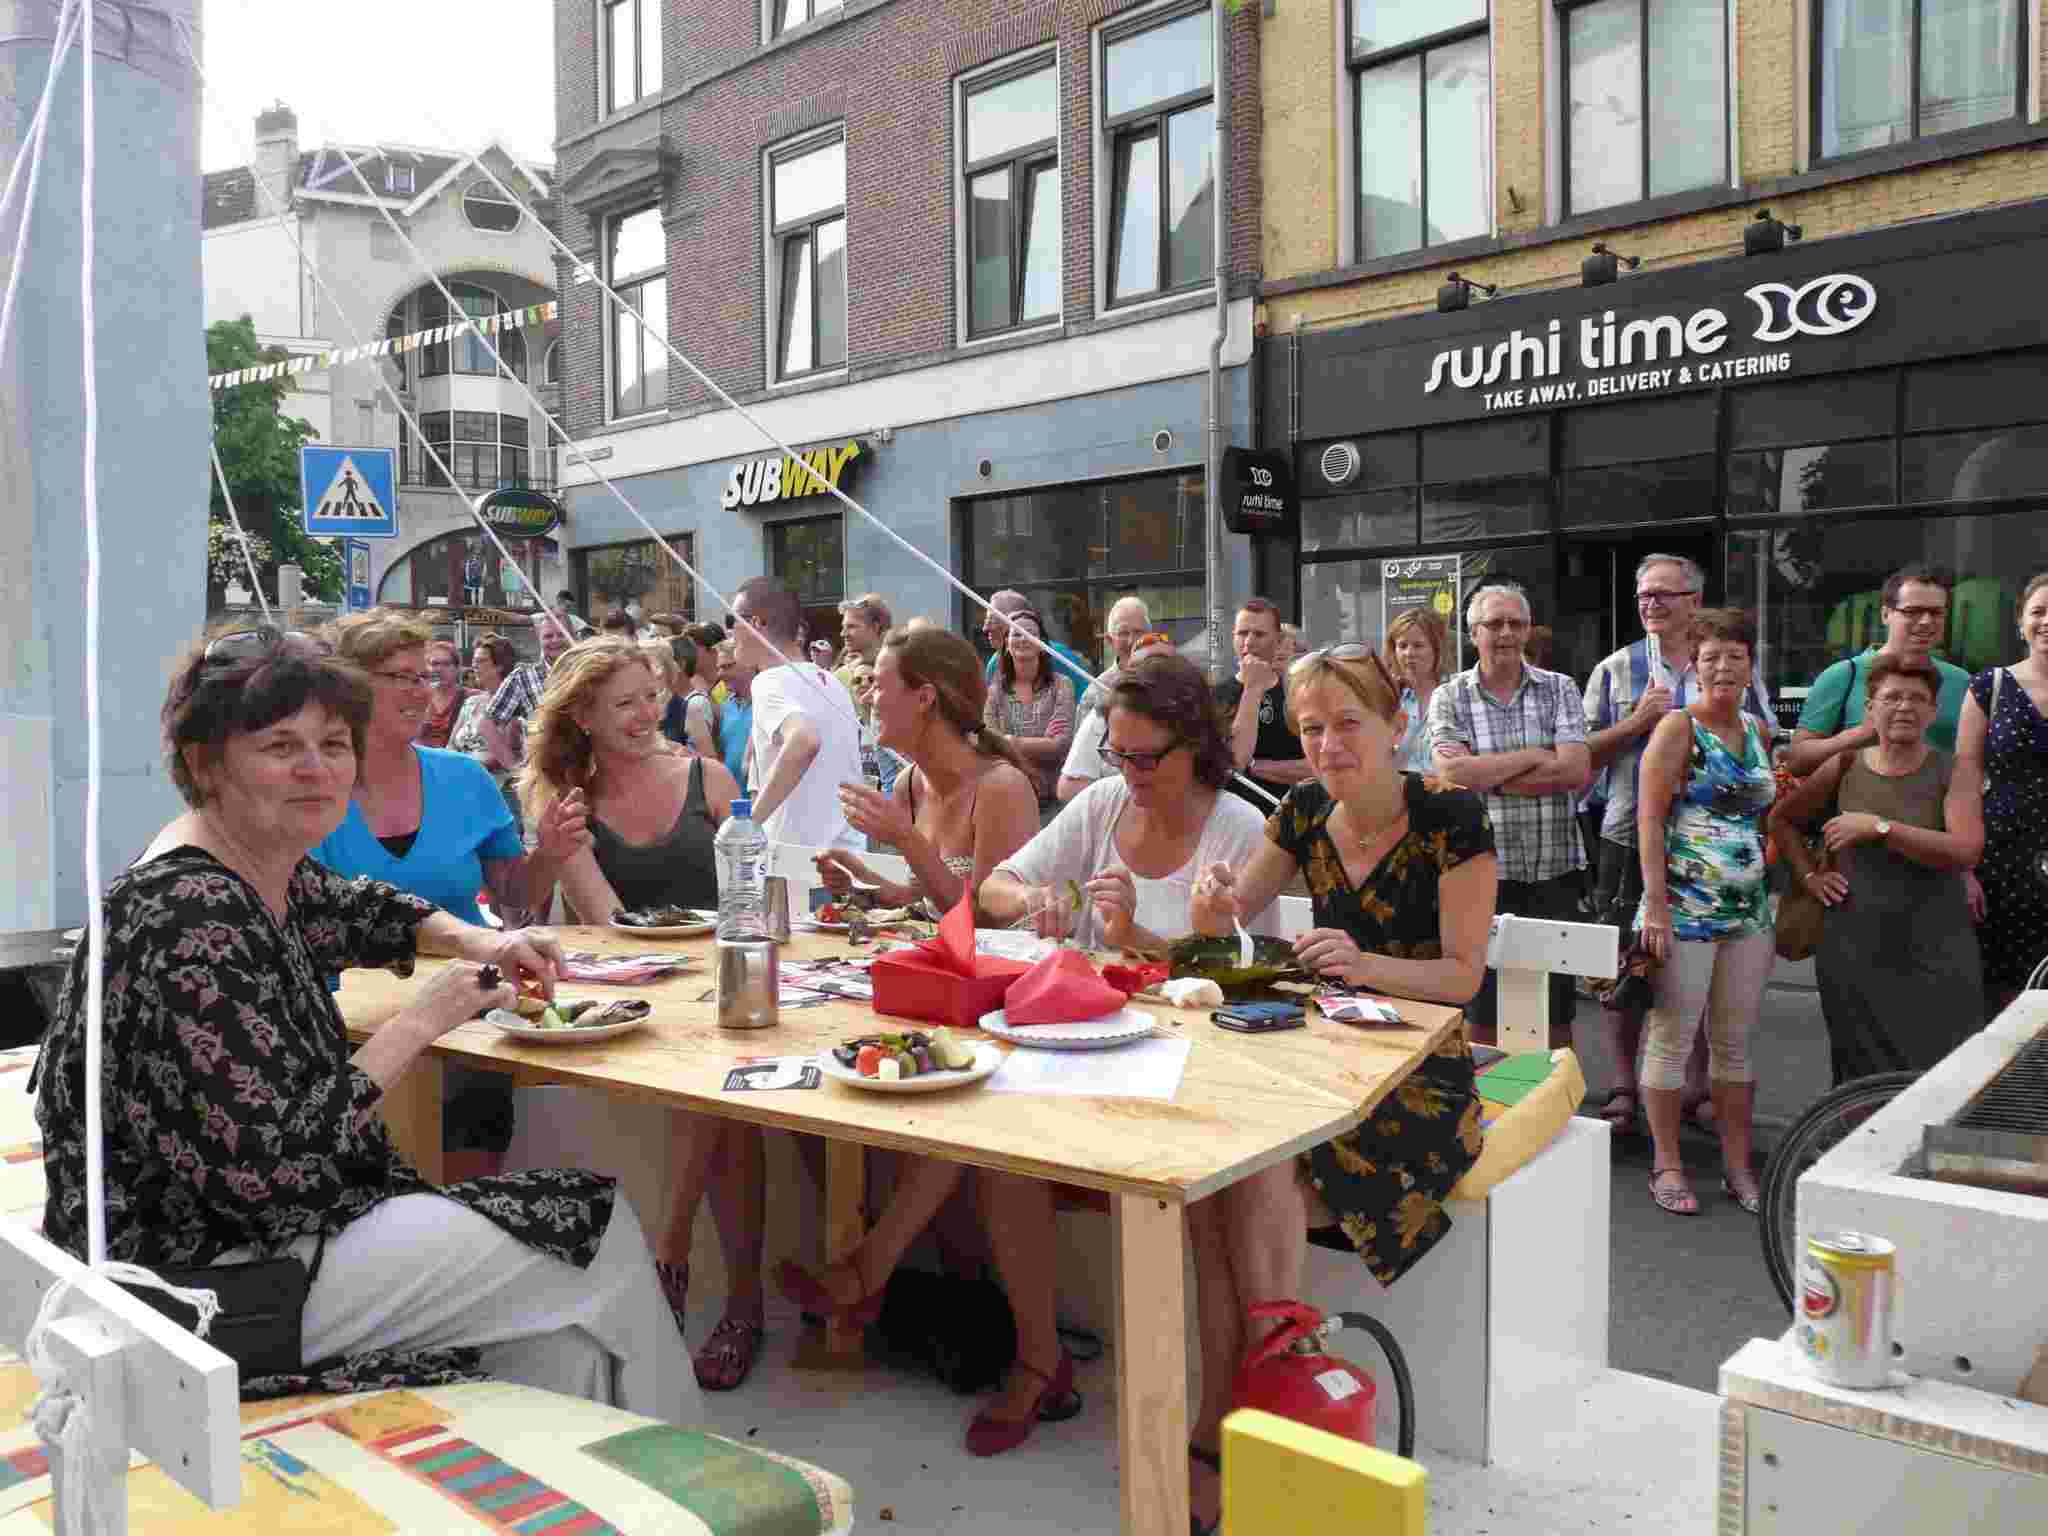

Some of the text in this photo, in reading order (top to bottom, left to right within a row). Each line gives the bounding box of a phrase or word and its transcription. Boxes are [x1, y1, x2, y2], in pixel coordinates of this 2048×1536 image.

[1425, 309, 1728, 393] sushi time
[1484, 352, 1792, 410] TAKE AWAY, DELIVERY & CATERING
[720, 439, 860, 512] SUBWAY
[482, 505, 554, 525] SUBWAY
